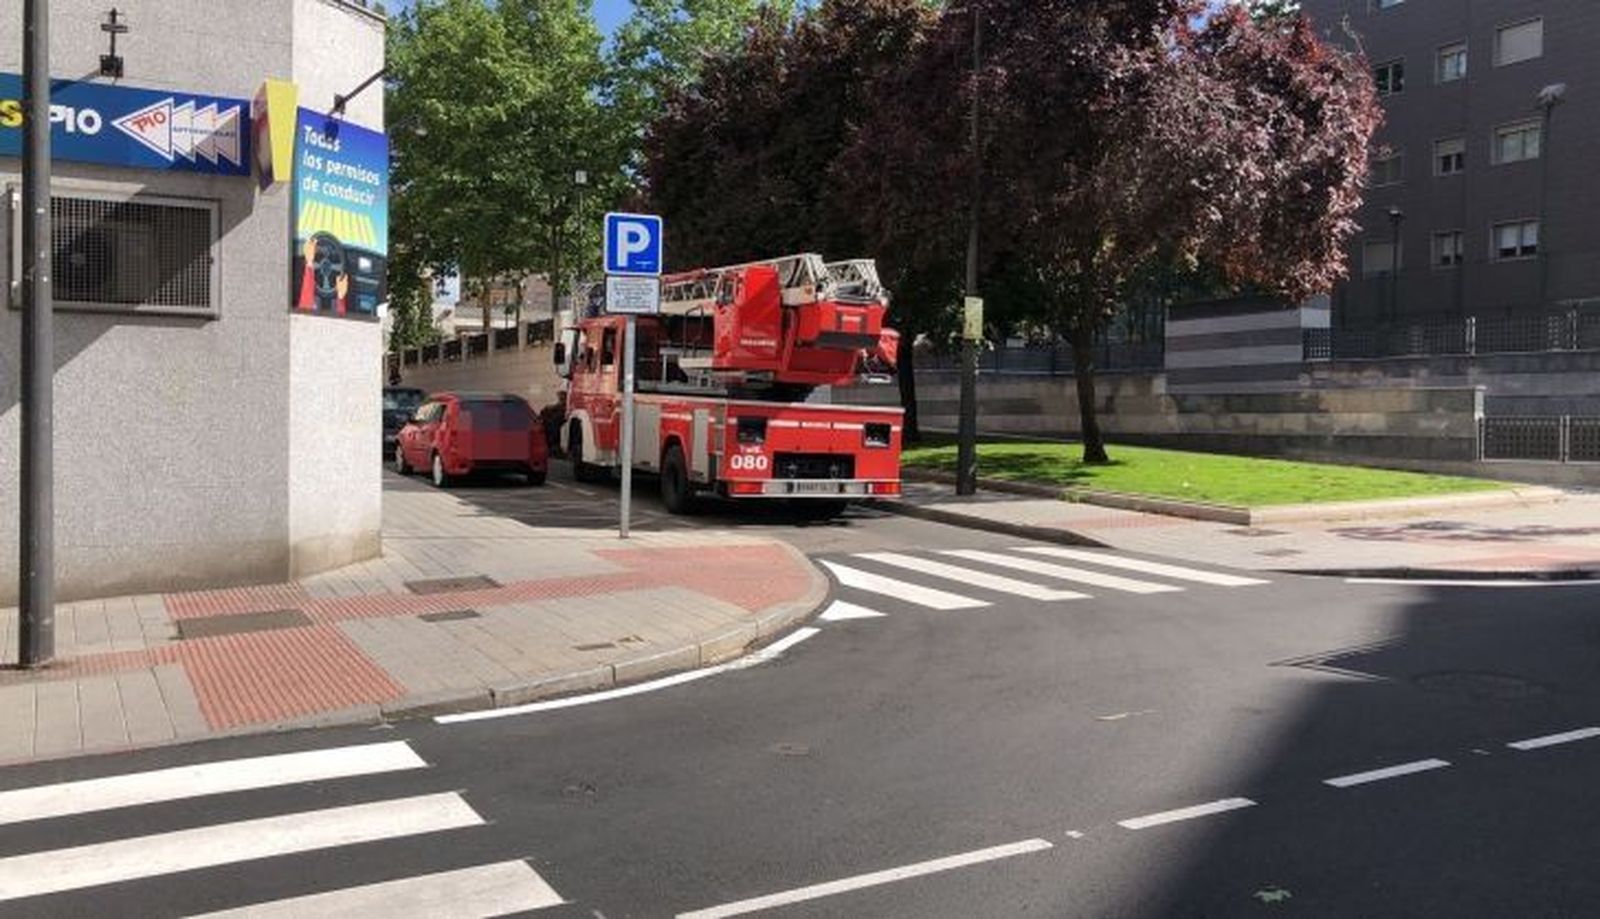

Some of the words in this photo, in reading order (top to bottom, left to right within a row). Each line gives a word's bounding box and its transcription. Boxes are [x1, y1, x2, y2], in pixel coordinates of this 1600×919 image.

[49, 104, 102, 135] PIO
[131, 111, 167, 133] PIO
[304, 125, 341, 152] Todos
[303, 149, 323, 171] los
[326, 160, 380, 186] permisos
[302, 174, 320, 193] de
[322, 181, 375, 206] conducir
[617, 221, 651, 268] P
[731, 454, 768, 470] 080
